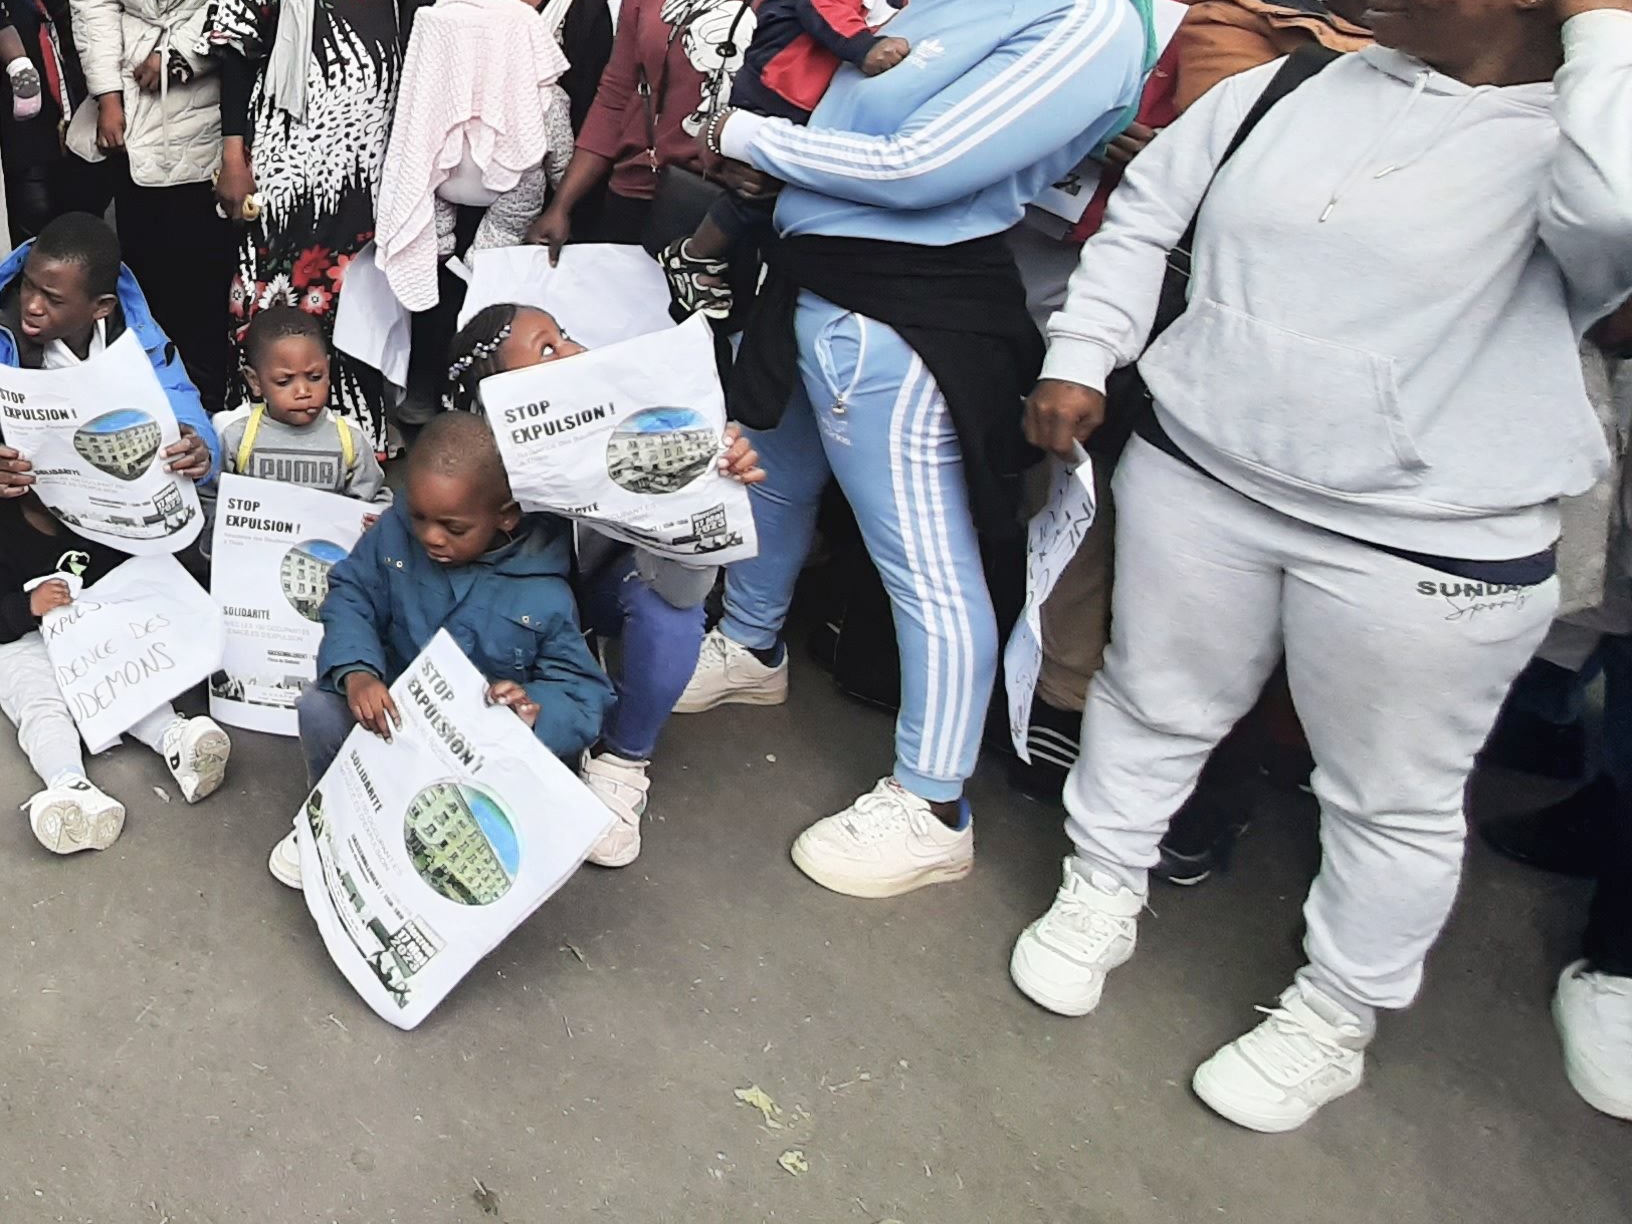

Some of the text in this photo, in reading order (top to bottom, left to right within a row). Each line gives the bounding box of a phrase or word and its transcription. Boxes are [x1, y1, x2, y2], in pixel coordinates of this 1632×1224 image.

[0, 388, 26, 404] STOP
[3, 405, 69, 421] EXPULSION
[504, 400, 551, 424] STOP
[511, 407, 606, 445] EXPULSION
[260, 458, 333, 484] PUMA
[228, 497, 260, 512] STOP
[226, 514, 293, 533] EXPULSION
[128, 614, 171, 640] DES
[421, 656, 455, 702] STOP
[407, 676, 475, 767] EXPULSION
